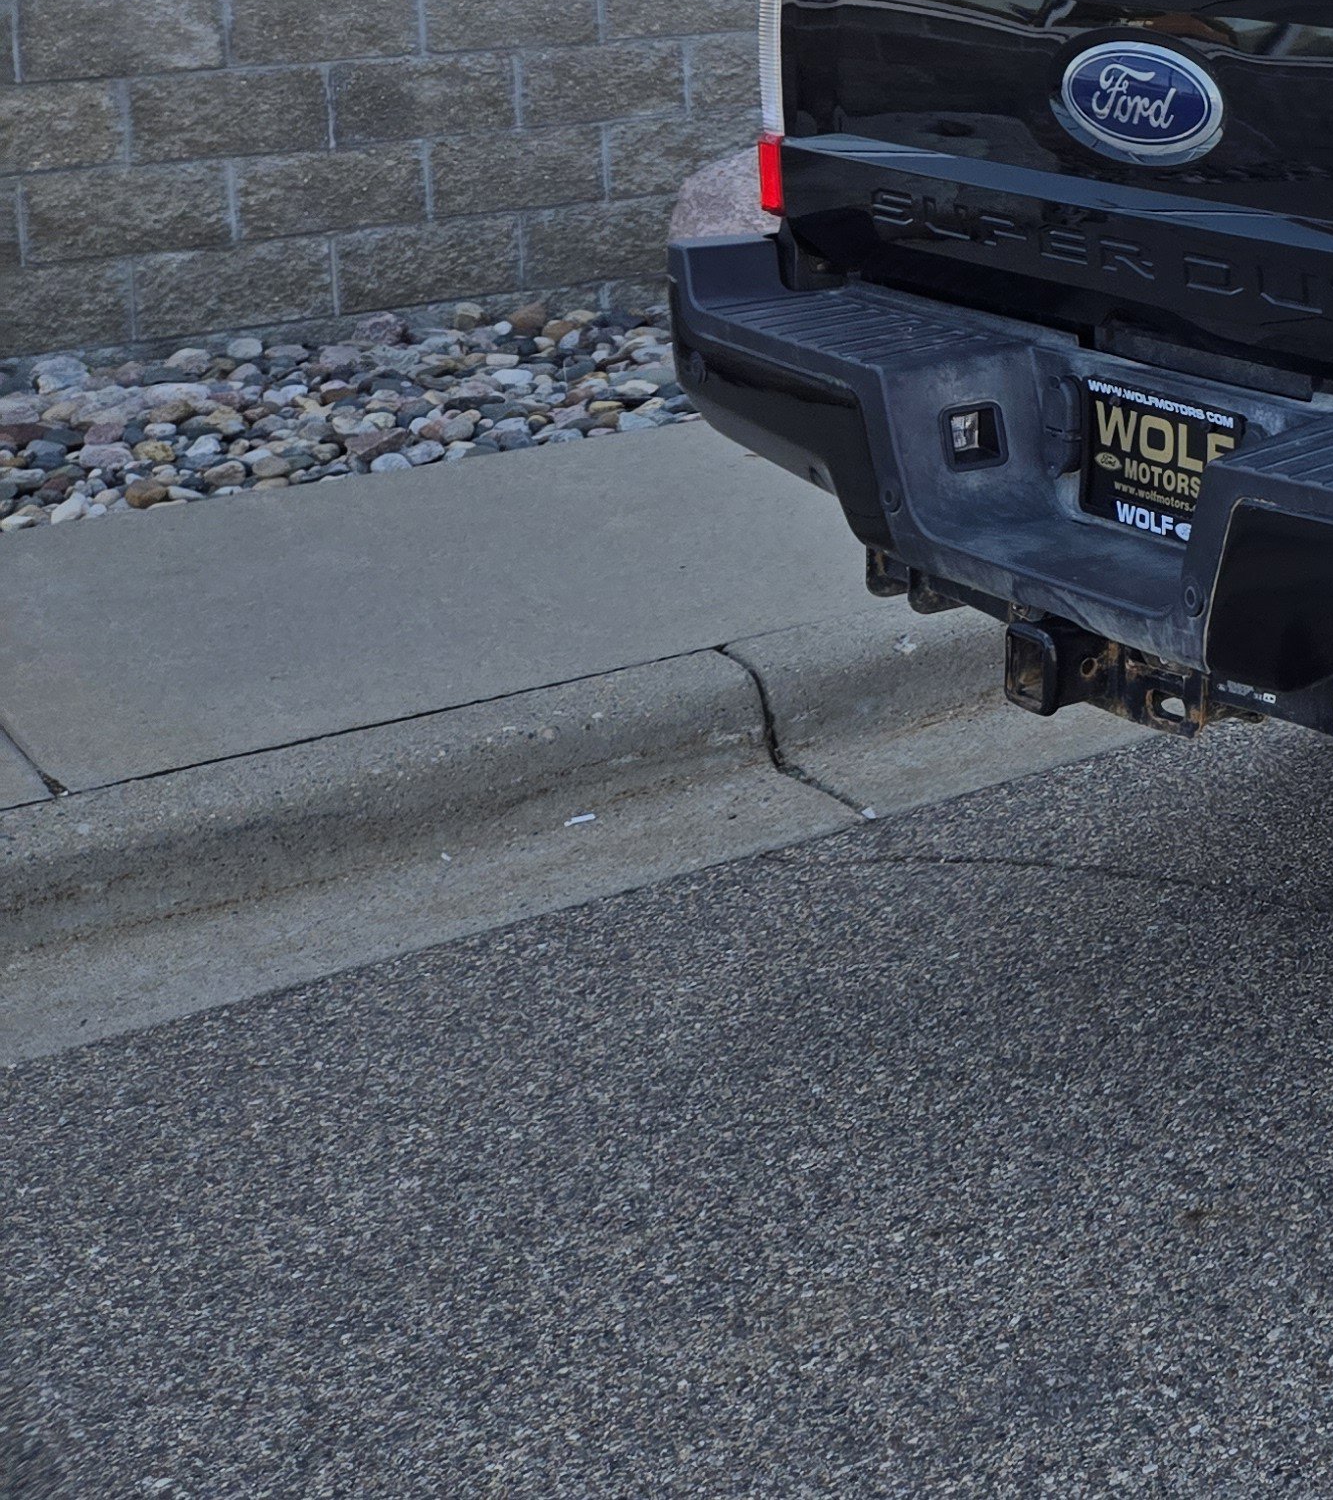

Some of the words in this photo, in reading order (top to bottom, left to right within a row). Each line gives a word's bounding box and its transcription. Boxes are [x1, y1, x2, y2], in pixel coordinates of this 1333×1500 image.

[1091, 62, 1177, 130] Ford
[871, 186, 1156, 281] SUPER
[1087, 378, 1234, 429] WWW.WOLFMOTORSCOM
[1095, 399, 1235, 473] WOLF
[1125, 457, 1201, 498] MOTORS
[1116, 500, 1174, 536] WOLF
